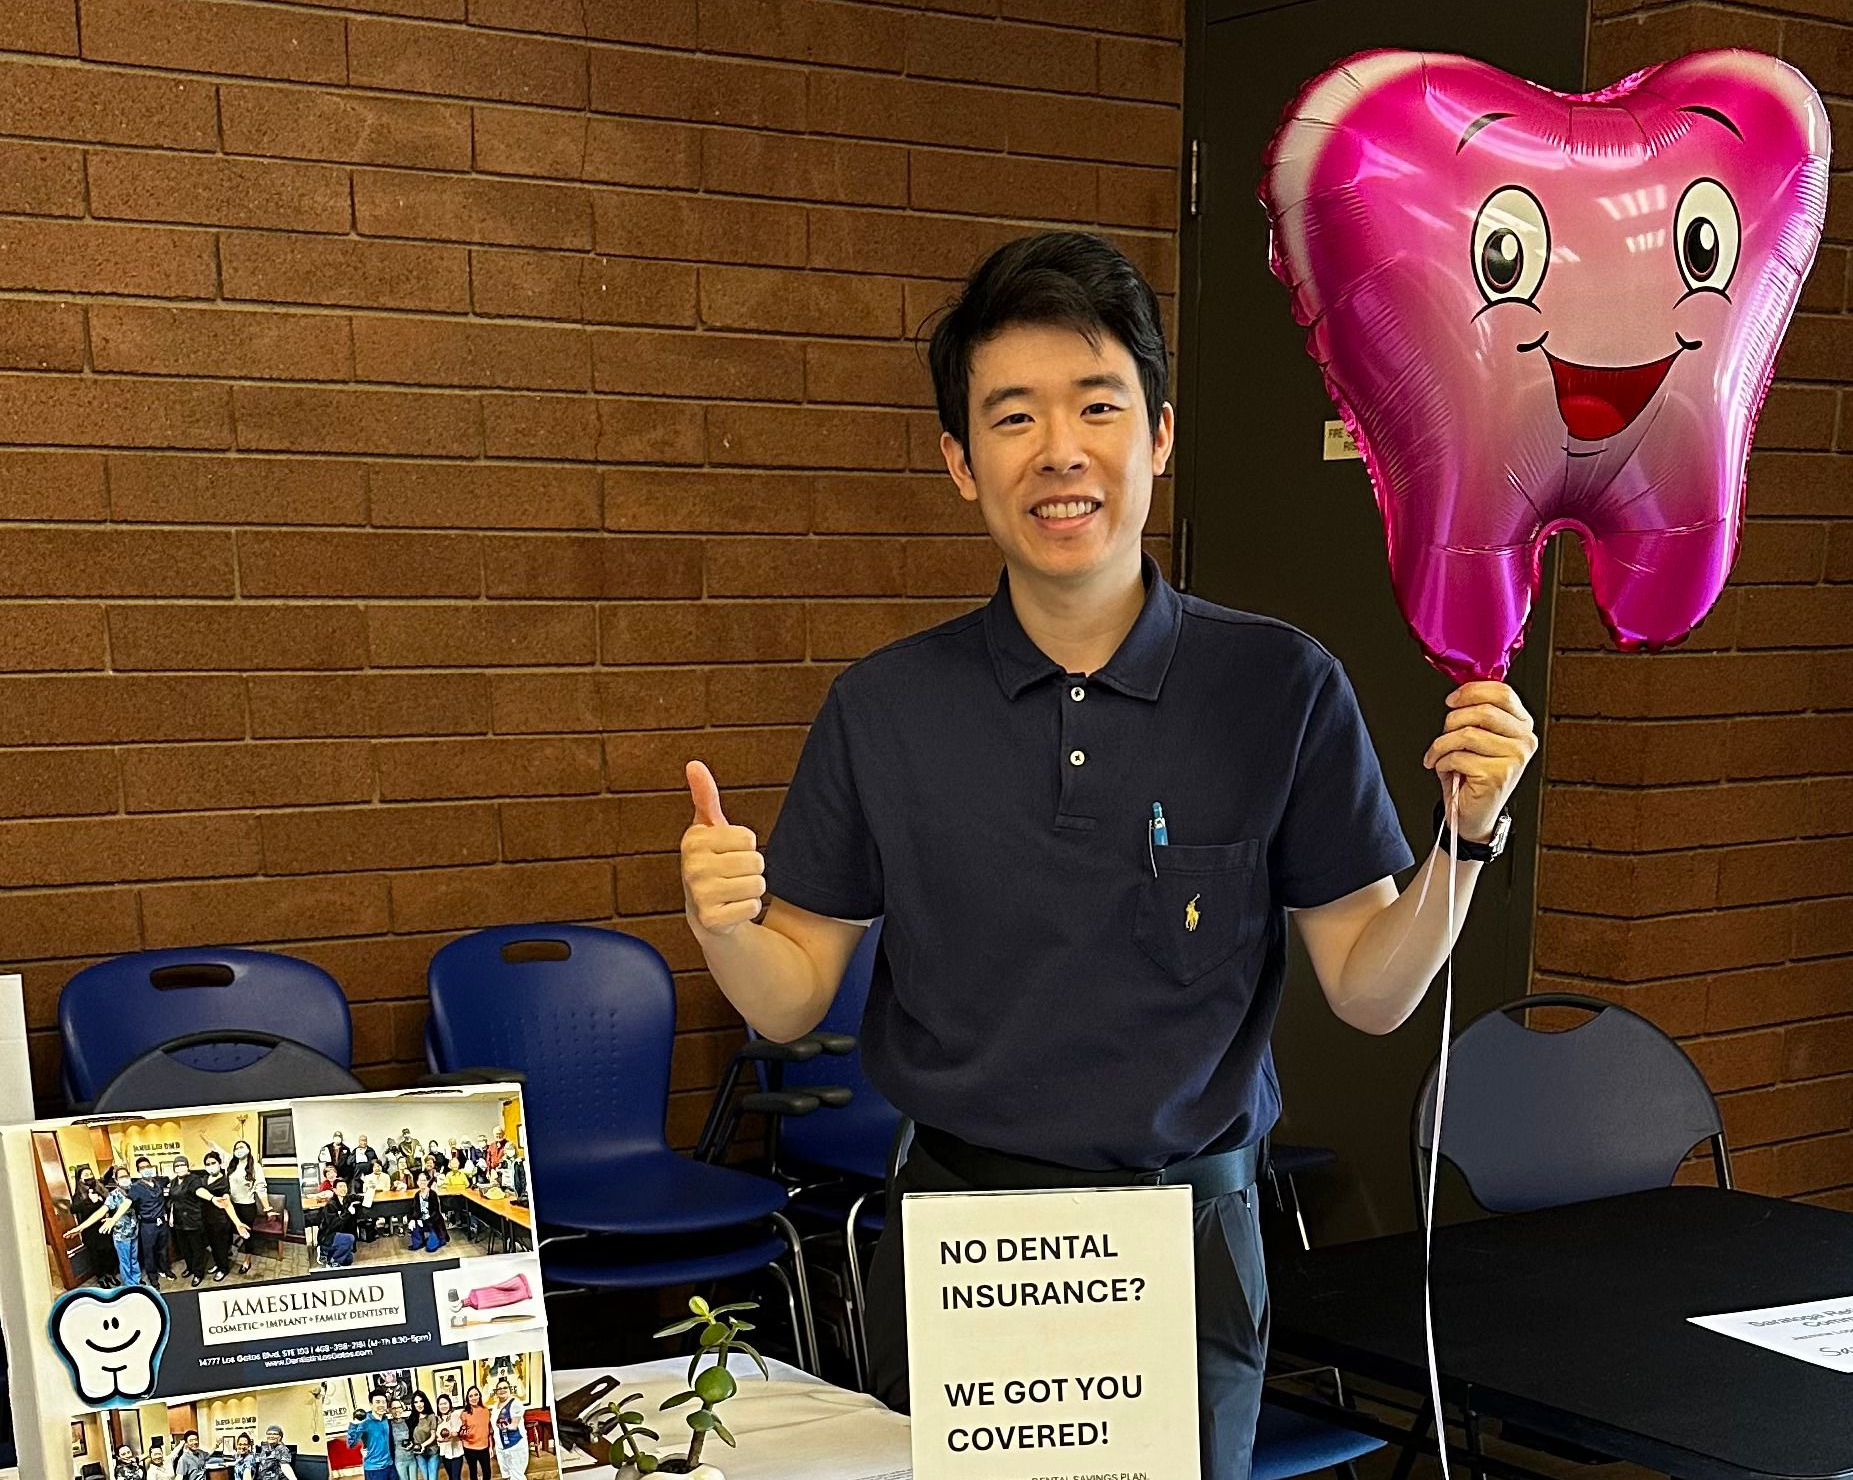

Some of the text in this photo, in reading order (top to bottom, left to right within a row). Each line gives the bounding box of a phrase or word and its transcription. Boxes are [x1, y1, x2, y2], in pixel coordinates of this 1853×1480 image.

[940, 1234, 1118, 1264] NO DENTAL
[942, 1277, 1146, 1310] INSURANCE?
[208, 1306, 400, 1335] COSMETIC IMPLANT FAMILY DENTISTRY
[198, 1357, 220, 1367] 14777
[281, 1349, 295, 1357] STE
[944, 1375, 1142, 1407] WE GOT YOU
[947, 1421, 1109, 1452] COVERED!
